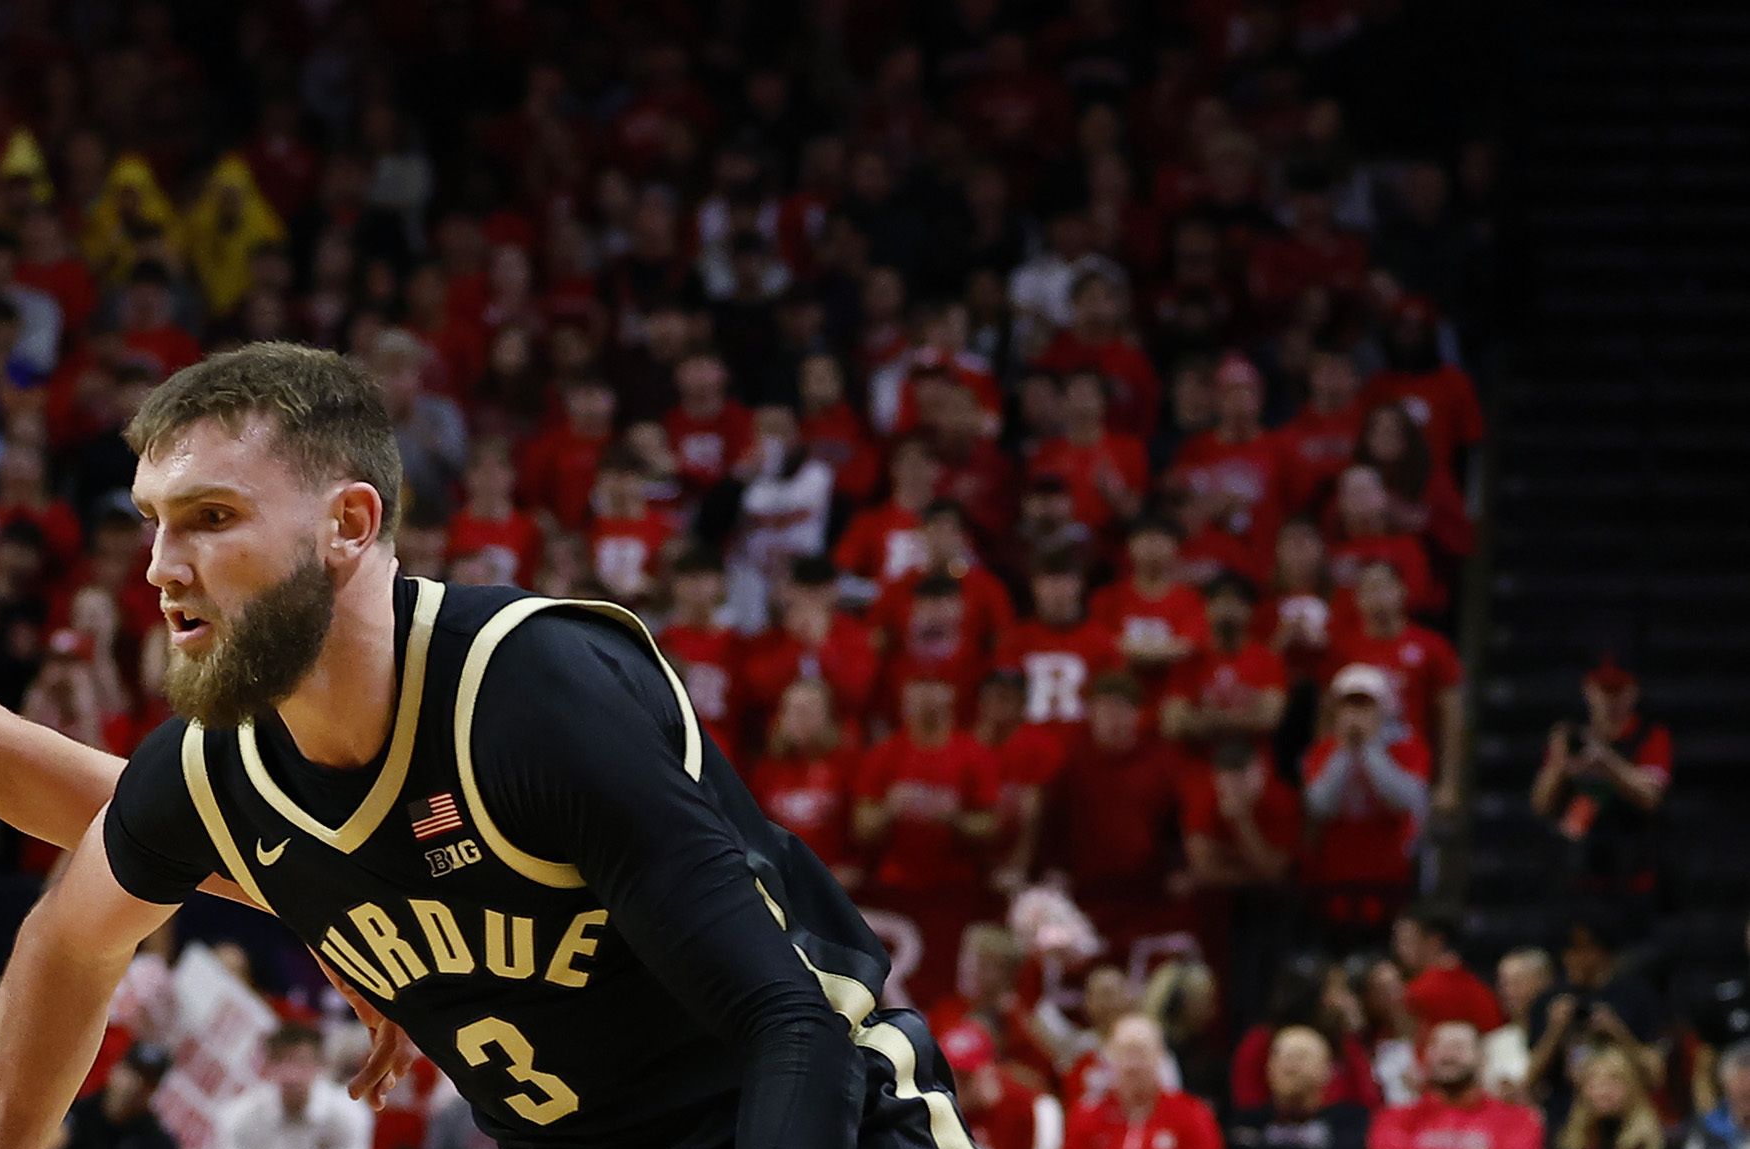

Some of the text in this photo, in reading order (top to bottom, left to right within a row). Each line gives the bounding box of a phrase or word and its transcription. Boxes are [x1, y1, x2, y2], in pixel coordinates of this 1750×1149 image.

[1023, 651, 1087, 723] R
[319, 897, 611, 1002] URDUE
[455, 1015, 580, 1126] 3
